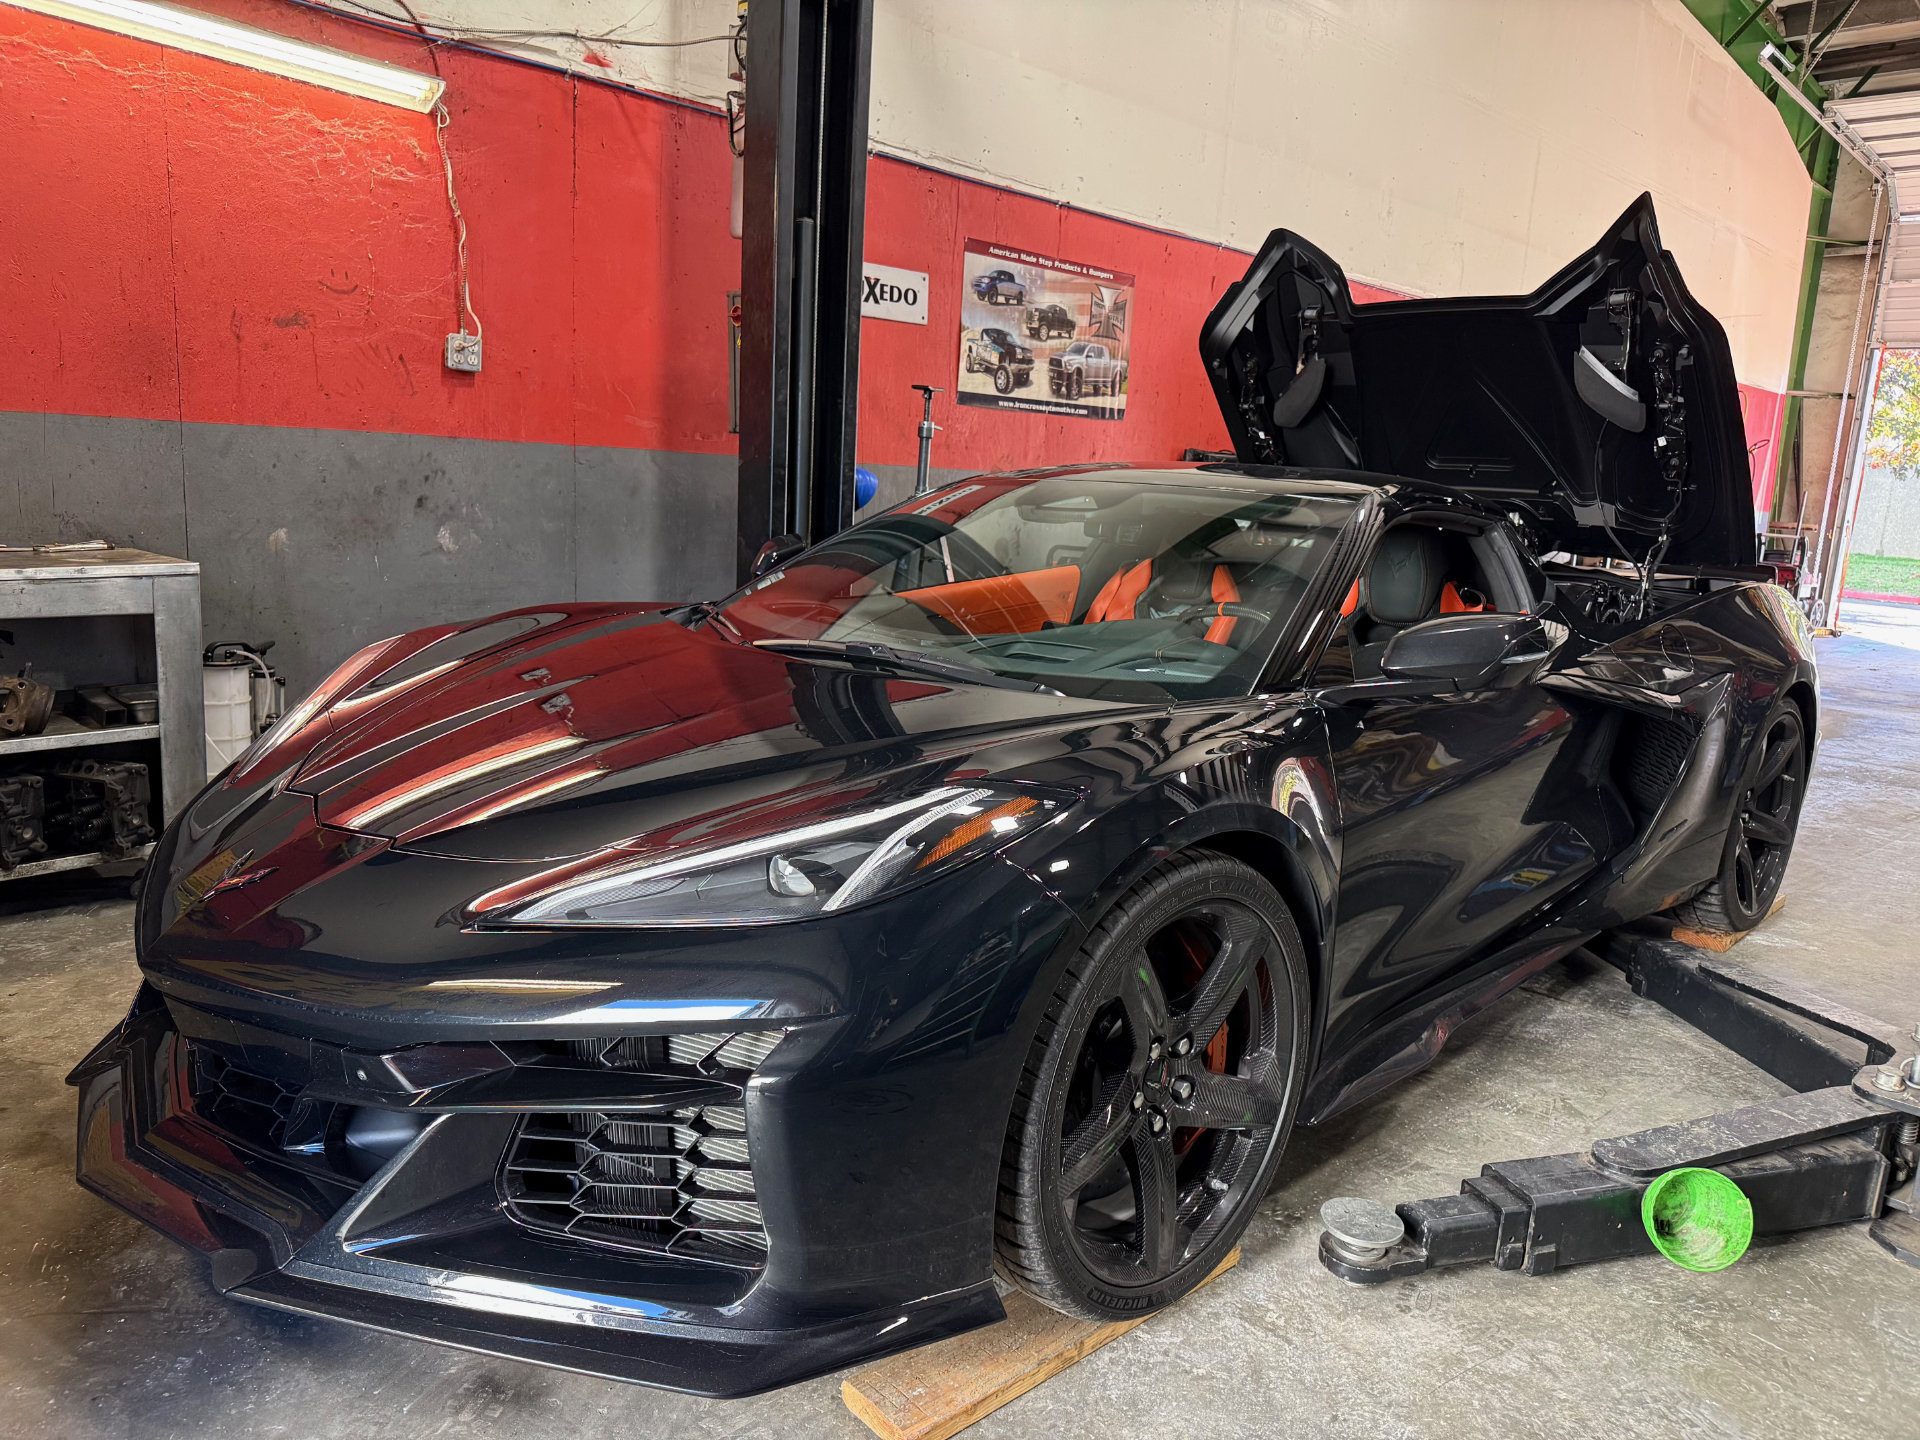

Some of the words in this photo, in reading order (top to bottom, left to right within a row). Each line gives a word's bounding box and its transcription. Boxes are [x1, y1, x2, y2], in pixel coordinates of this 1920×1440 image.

[989, 247, 1019, 259] American
[1020, 254, 1037, 263] Made
[1038, 257, 1053, 268] Step
[1054, 261, 1081, 272] Products
[1082, 266, 1088, 274] &
[1089, 268, 1113, 279] Bumpers
[862, 276, 918, 305] XEDO
[1090, 1288, 1149, 1310] MICHELIN
